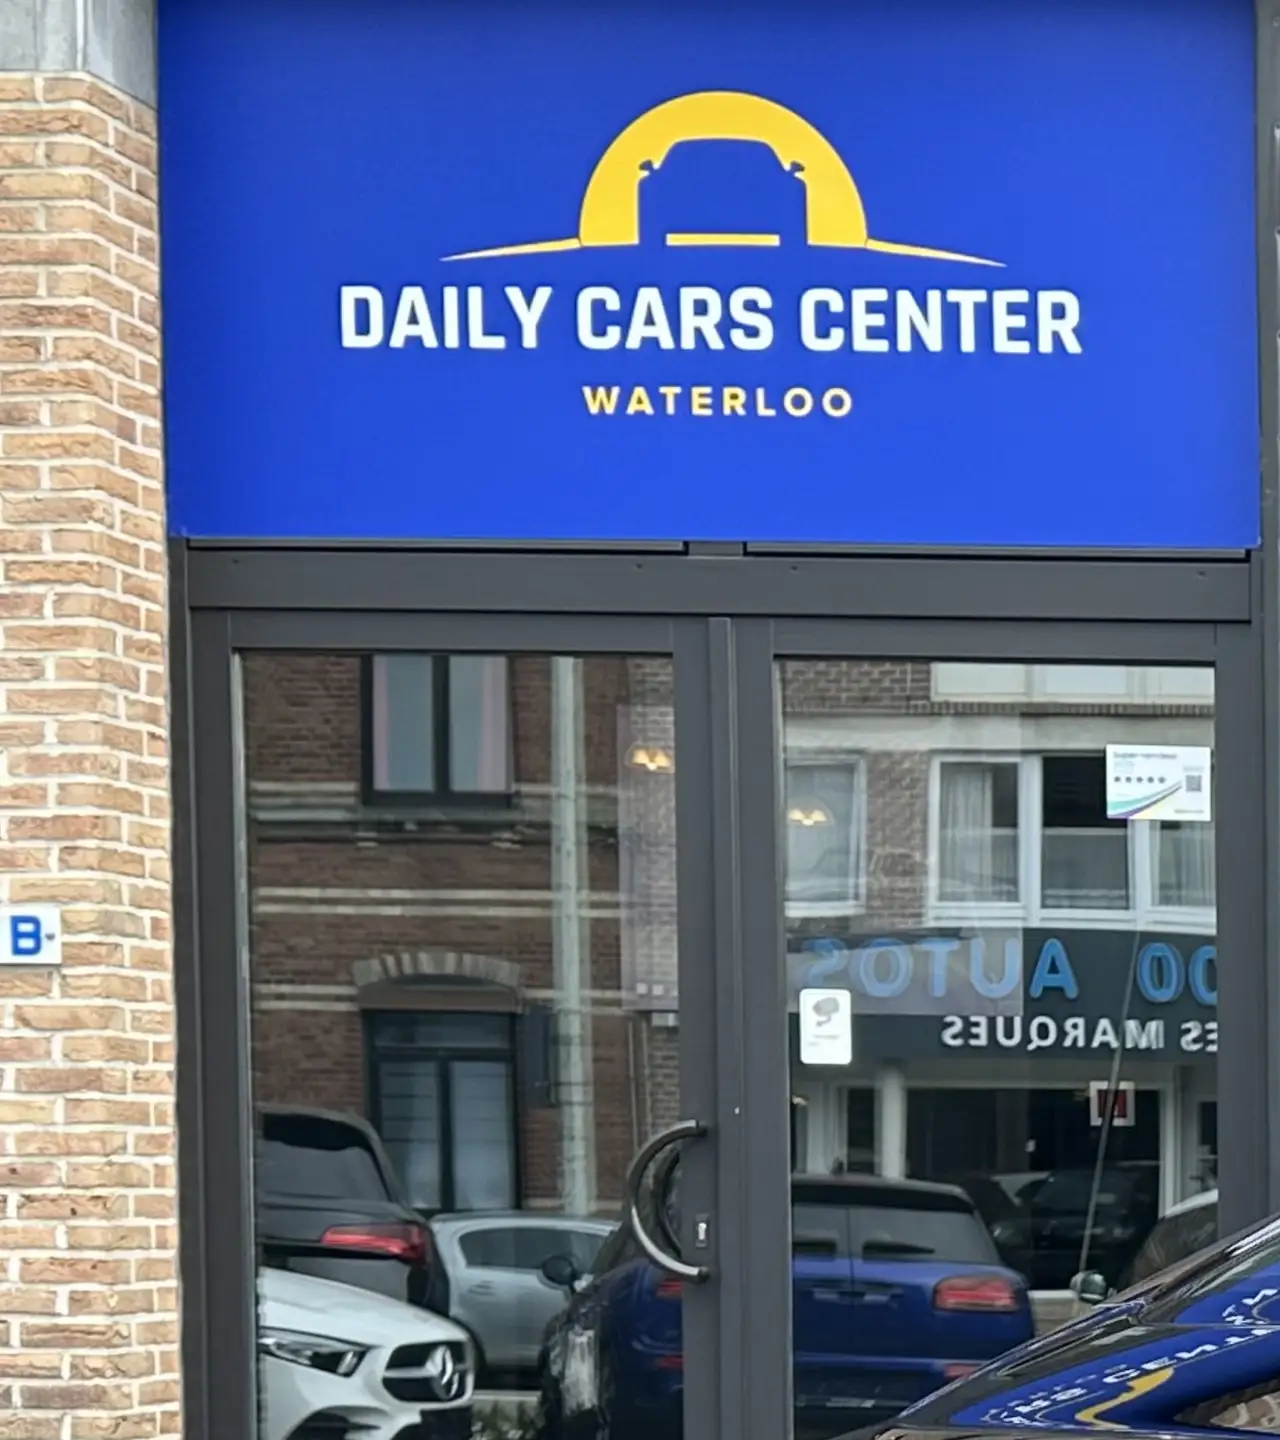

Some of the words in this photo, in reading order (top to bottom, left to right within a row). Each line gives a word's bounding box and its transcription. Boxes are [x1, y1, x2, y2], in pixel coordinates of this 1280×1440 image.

[340, 286, 553, 351] DAILY
[577, 287, 775, 352] CARS
[800, 288, 1084, 355] CENTER
[583, 386, 854, 419] WATERLOO
